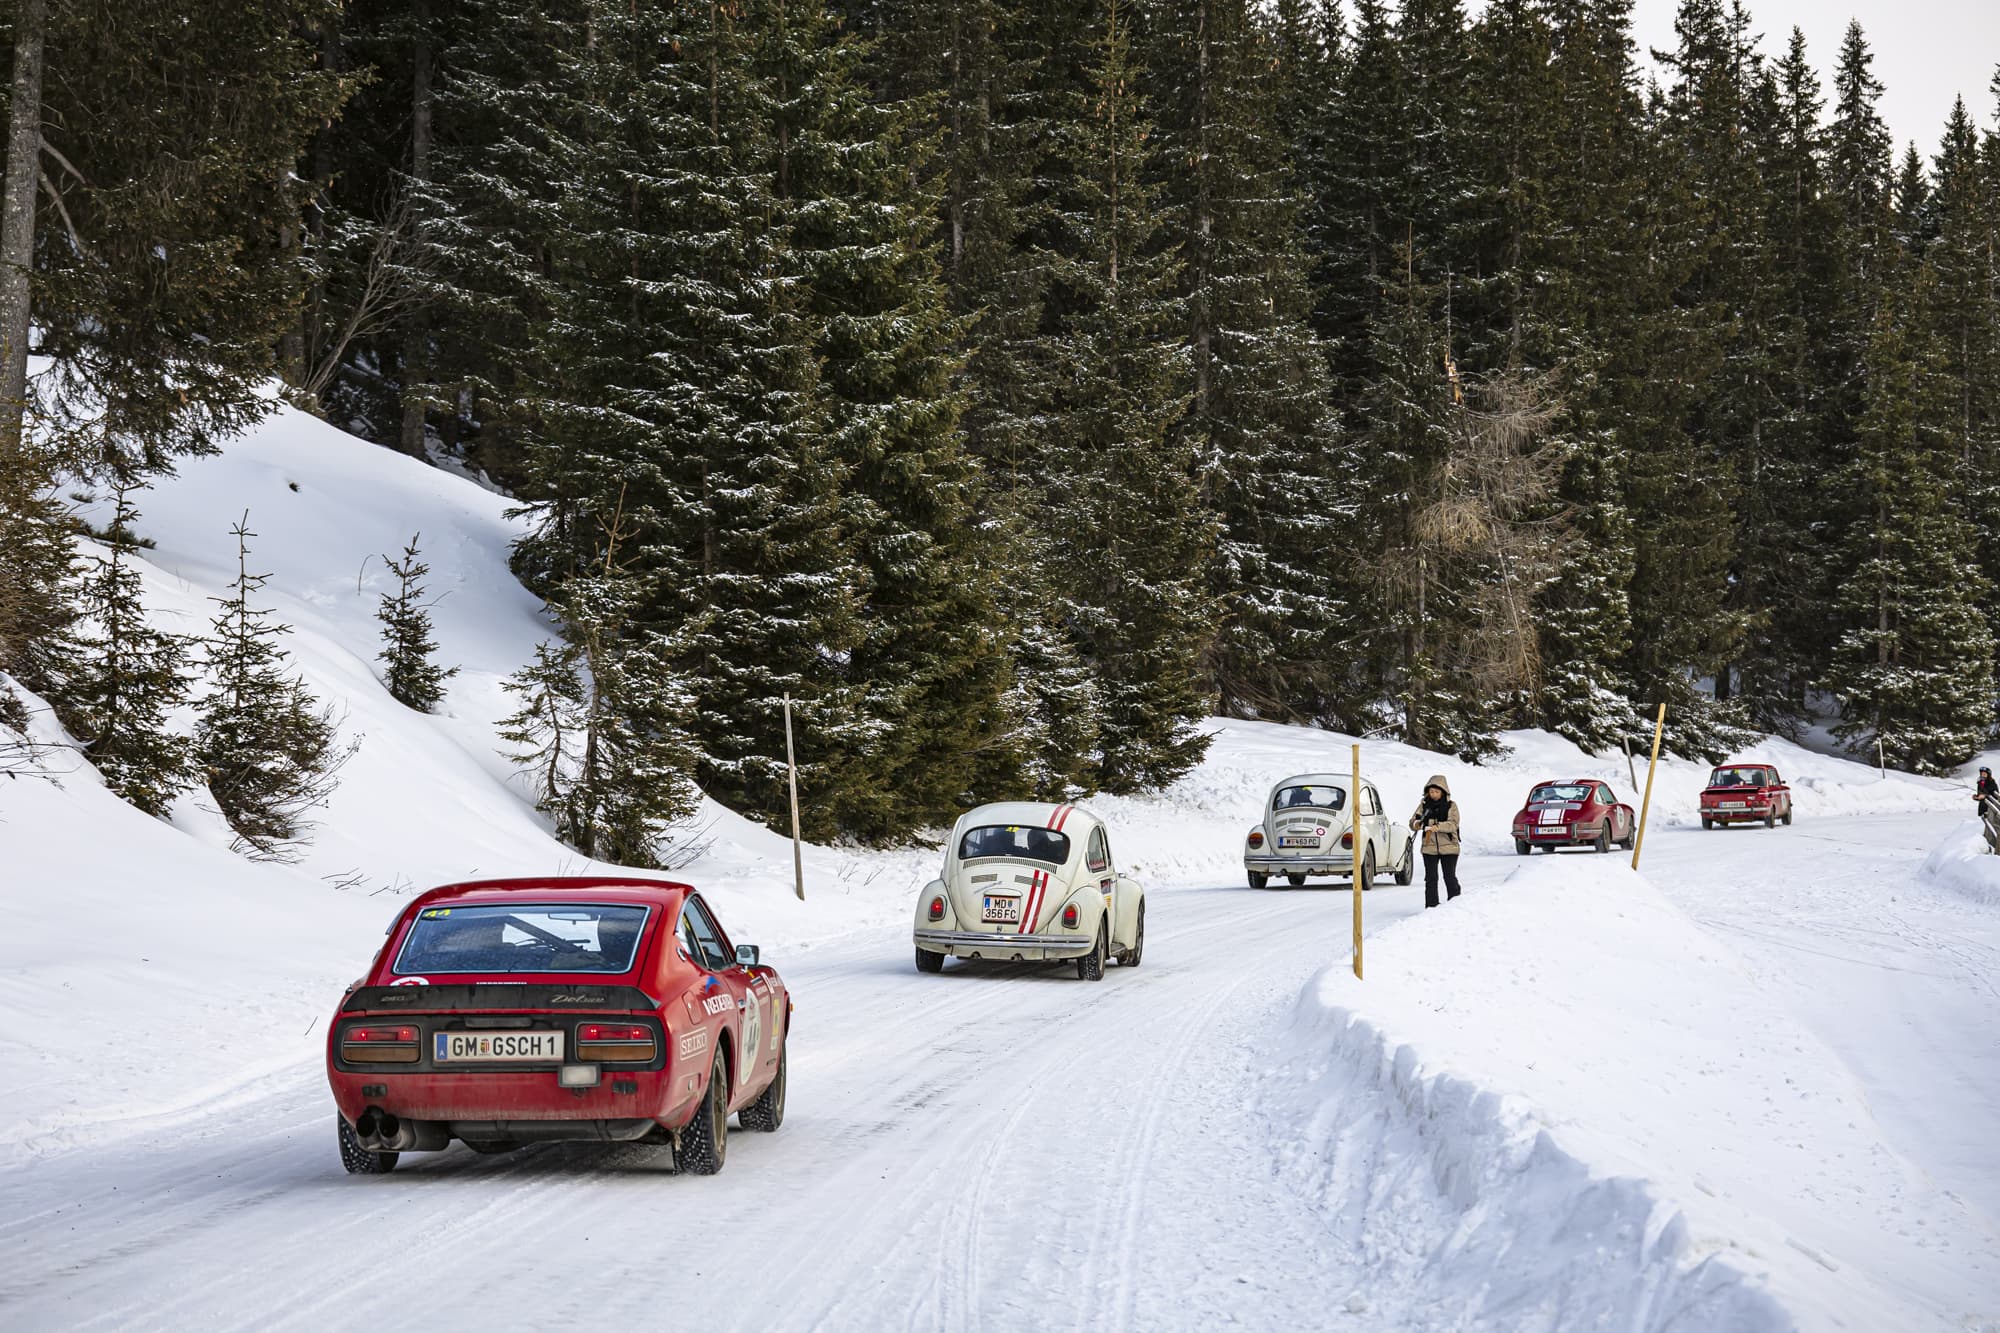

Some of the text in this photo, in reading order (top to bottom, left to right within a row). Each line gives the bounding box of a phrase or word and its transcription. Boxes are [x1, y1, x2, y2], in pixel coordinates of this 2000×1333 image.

[994, 899, 1007, 909] MD
[985, 908, 1017, 919] 356 FC
[452, 1036, 555, 1057] GM GSCH 1
[681, 1032, 707, 1056] SEIKO
